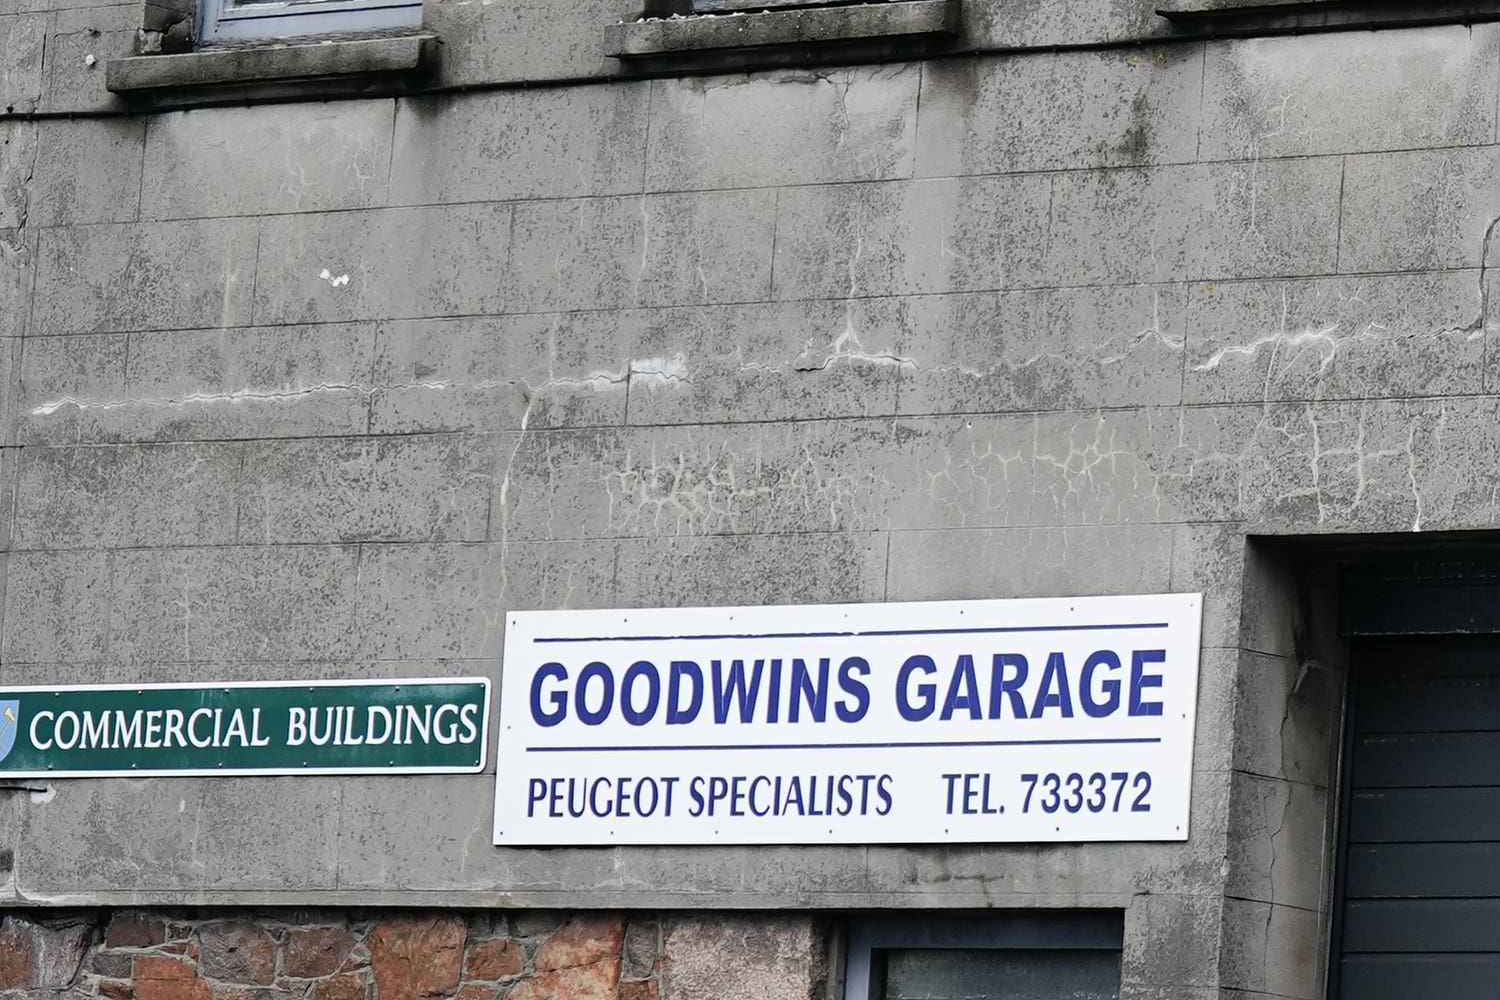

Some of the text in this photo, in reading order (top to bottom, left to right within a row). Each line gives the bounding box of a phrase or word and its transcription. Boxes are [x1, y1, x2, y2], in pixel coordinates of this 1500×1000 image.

[530, 650, 1166, 727] GOODWINS GARAGE
[30, 704, 477, 749] COMMERCIAL BUILDINGS
[529, 772, 1151, 817] PEUGEOT SPECIALISTS TEL. 733372
